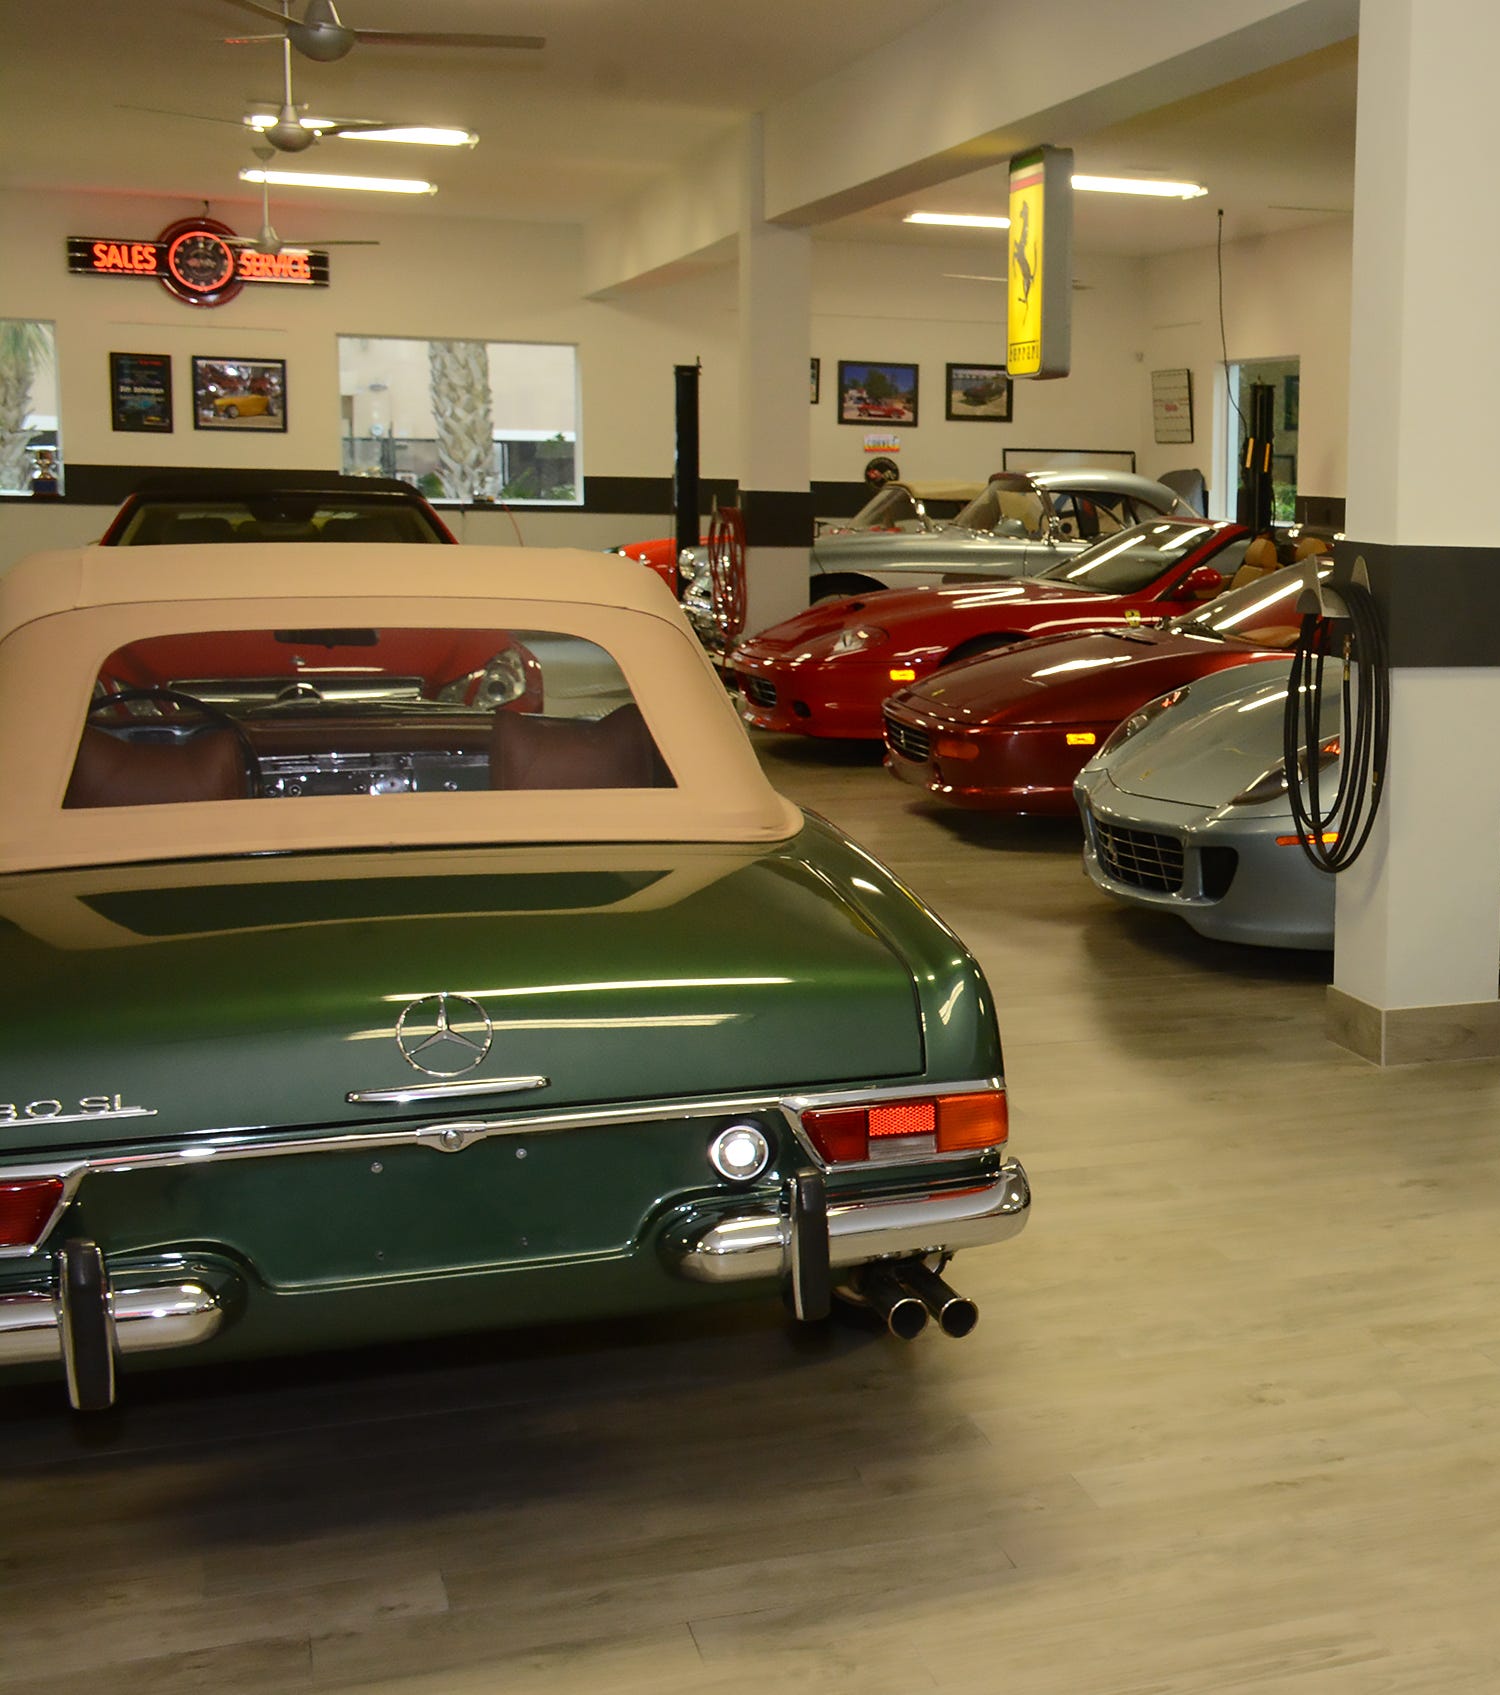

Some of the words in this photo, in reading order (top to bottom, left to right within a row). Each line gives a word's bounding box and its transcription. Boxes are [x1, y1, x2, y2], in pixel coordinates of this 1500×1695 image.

[93, 243, 157, 270] SALES
[238, 252, 311, 279] SERVICE
[79, 1093, 142, 1114] SL
